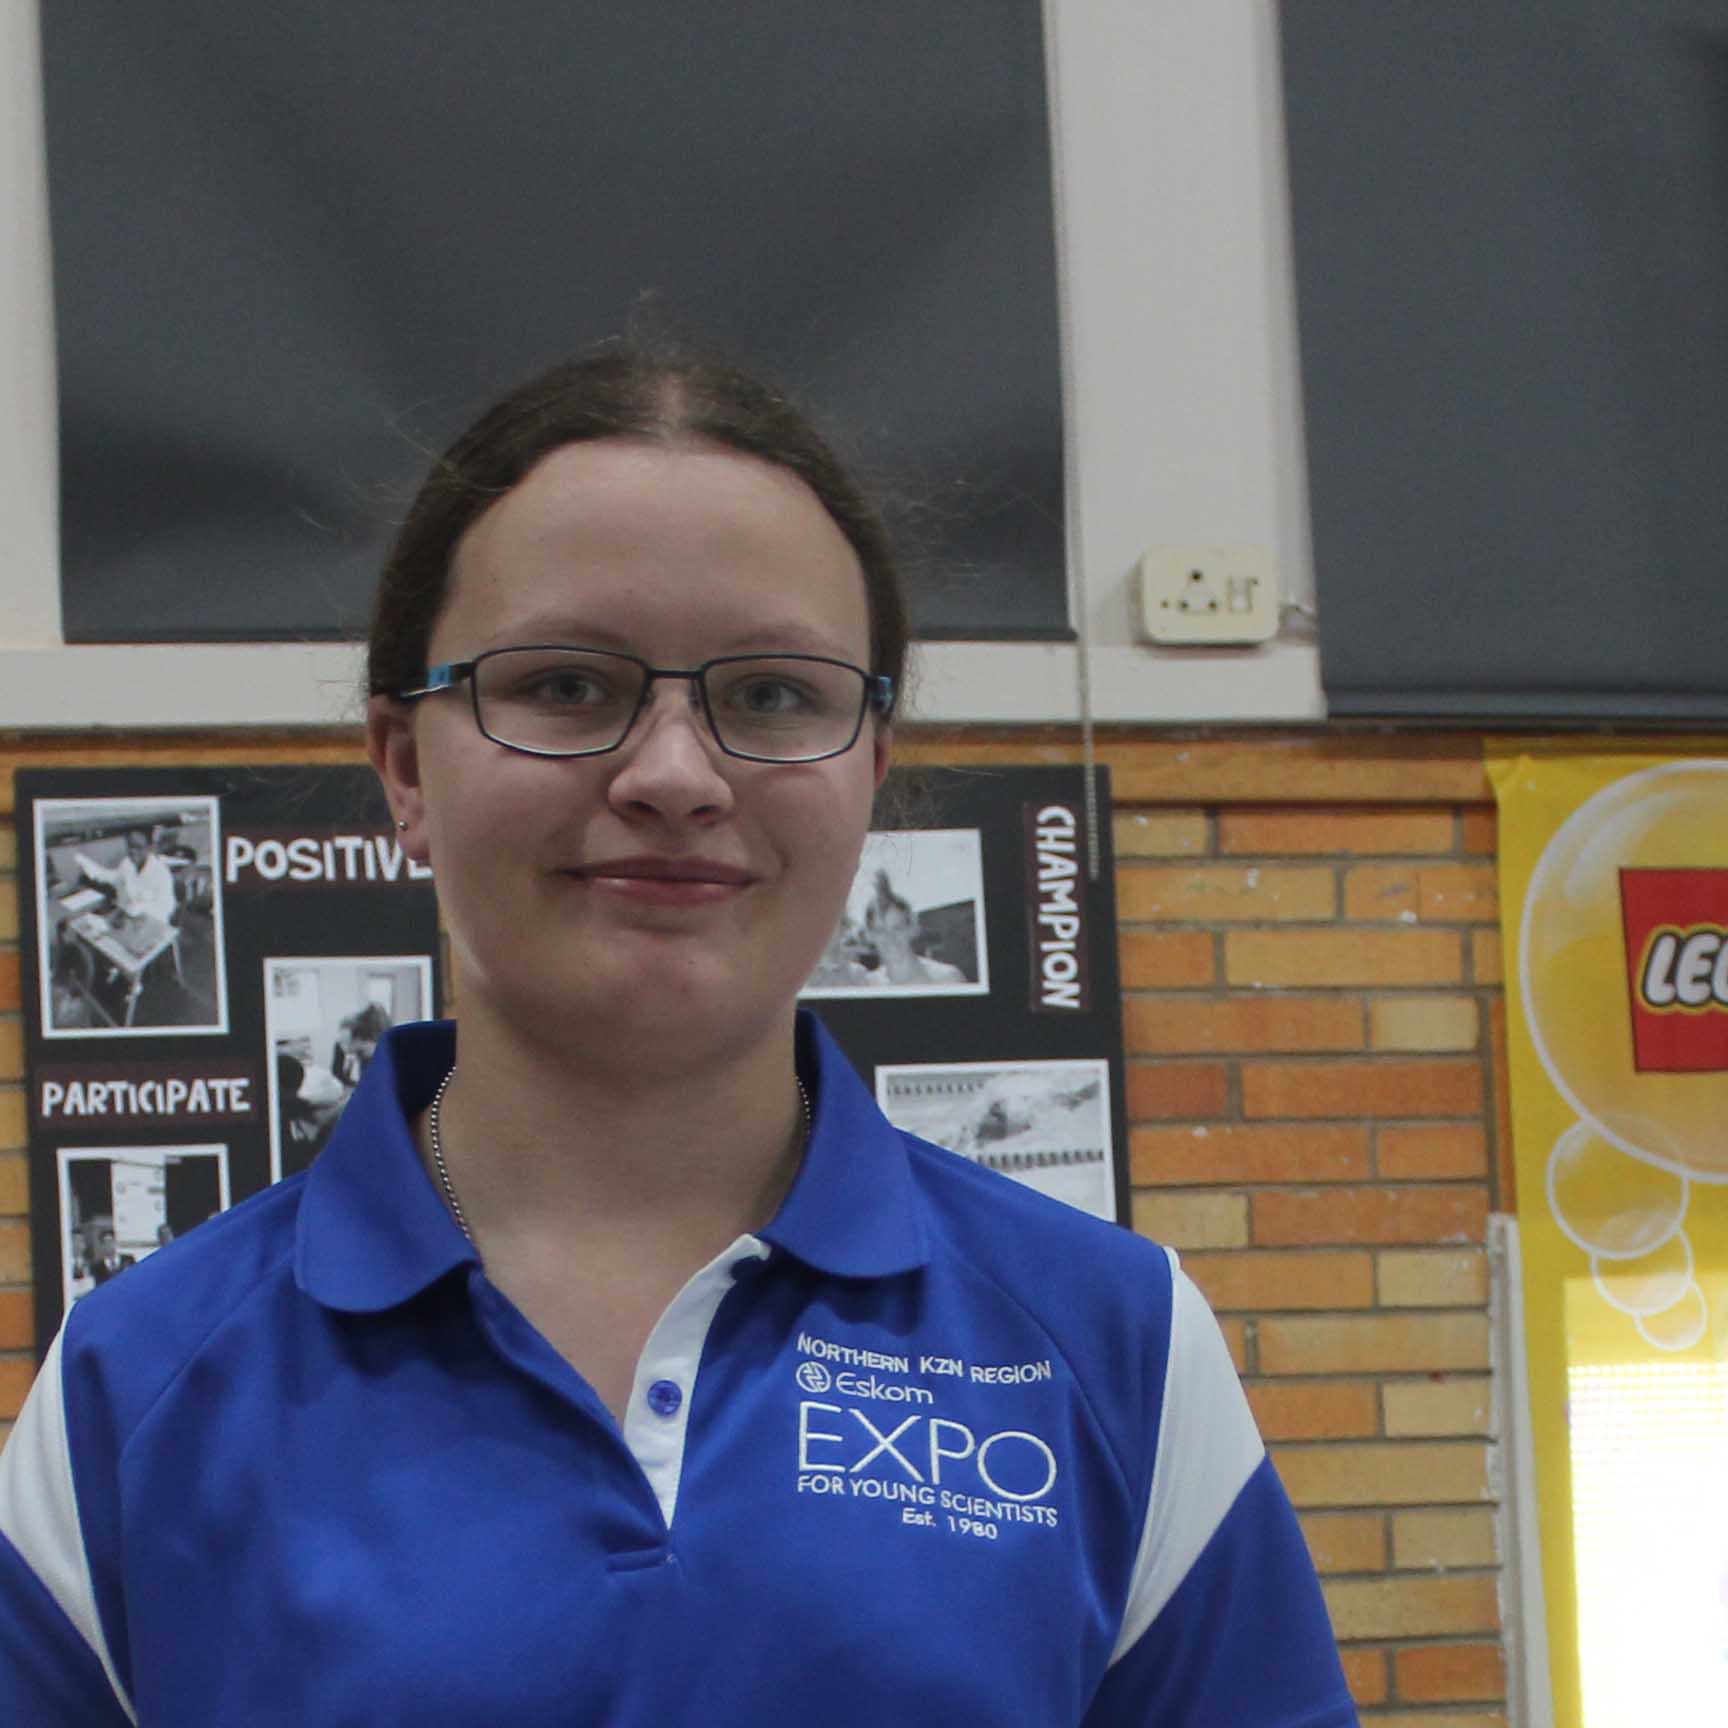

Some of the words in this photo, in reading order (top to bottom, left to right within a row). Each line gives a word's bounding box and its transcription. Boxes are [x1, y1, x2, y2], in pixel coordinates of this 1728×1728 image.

[1036, 805, 1081, 1009] CHAMPION
[42, 1077, 251, 1117] PARTICIPATE
[797, 1332, 909, 1374] NORTHERN
[920, 1356, 963, 1378] KZN
[970, 1360, 1052, 1384] REGION
[835, 1372, 934, 1404] Eskom
[798, 1400, 1057, 1501] EXPO
[797, 1475, 844, 1494] FOR
[849, 1478, 935, 1505] YOUNG
[939, 1490, 1058, 1527] SCIENTISTS
[947, 1516, 997, 1540] 1980
